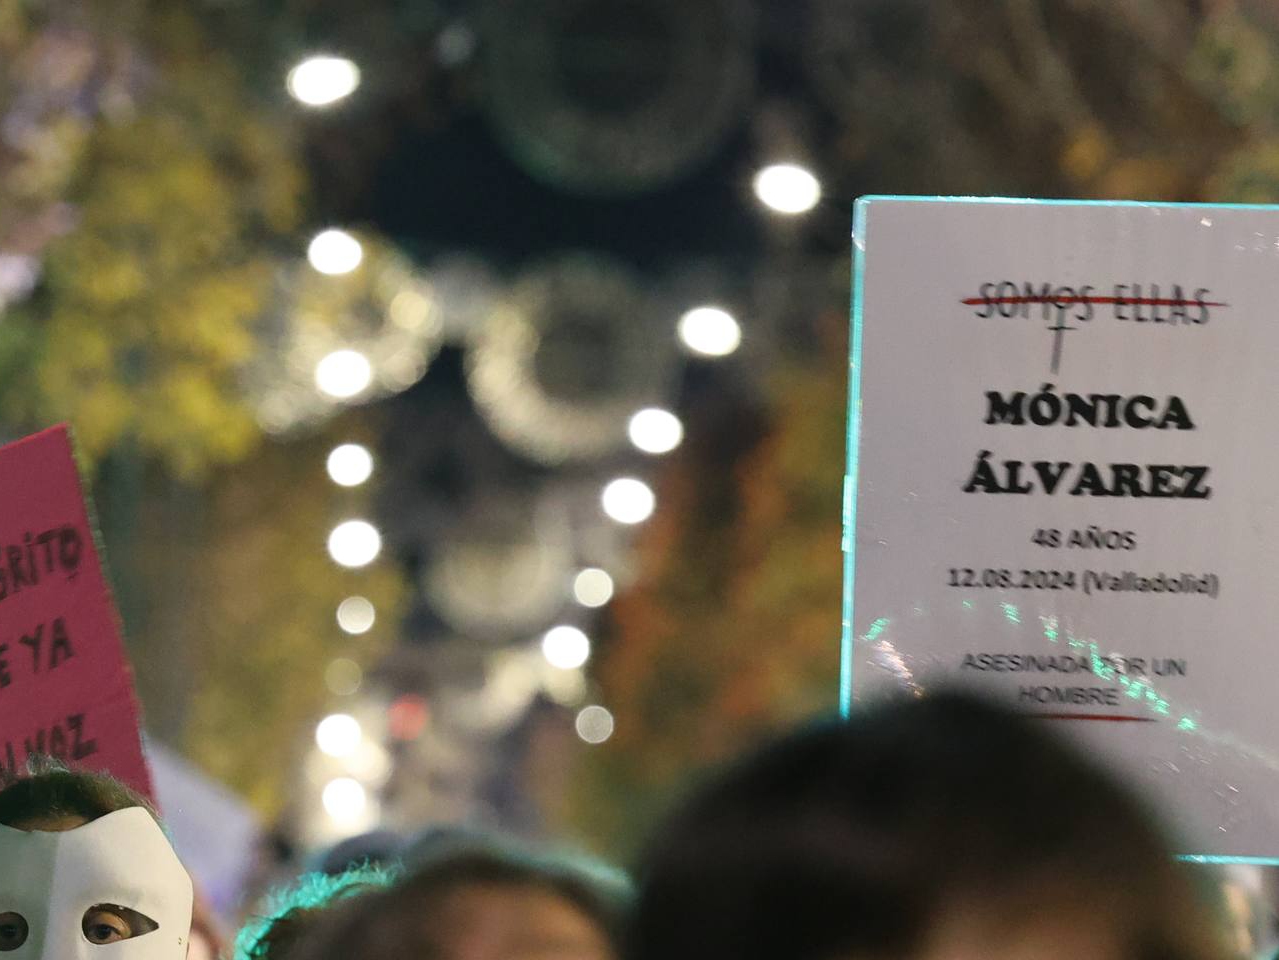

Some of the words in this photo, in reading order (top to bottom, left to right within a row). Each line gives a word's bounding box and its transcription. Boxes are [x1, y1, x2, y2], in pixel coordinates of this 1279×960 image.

[975, 281, 1097, 322] SOMOS
[1113, 283, 1211, 326] ELLAS
[984, 383, 1195, 430] MÓNICA
[964, 450, 1213, 499] ÁLVAREZ
[1031, 528, 1062, 549] 48
[1068, 525, 1138, 550] AÑOS
[948, 567, 1076, 590] 12.08.2024
[1083, 570, 1220, 599] (Valladolid)
[19, 617, 74, 673] YA
[961, 653, 1090, 674] ASESINADA
[1152, 657, 1187, 677] UN
[1020, 687, 1121, 706] HOMBRE
